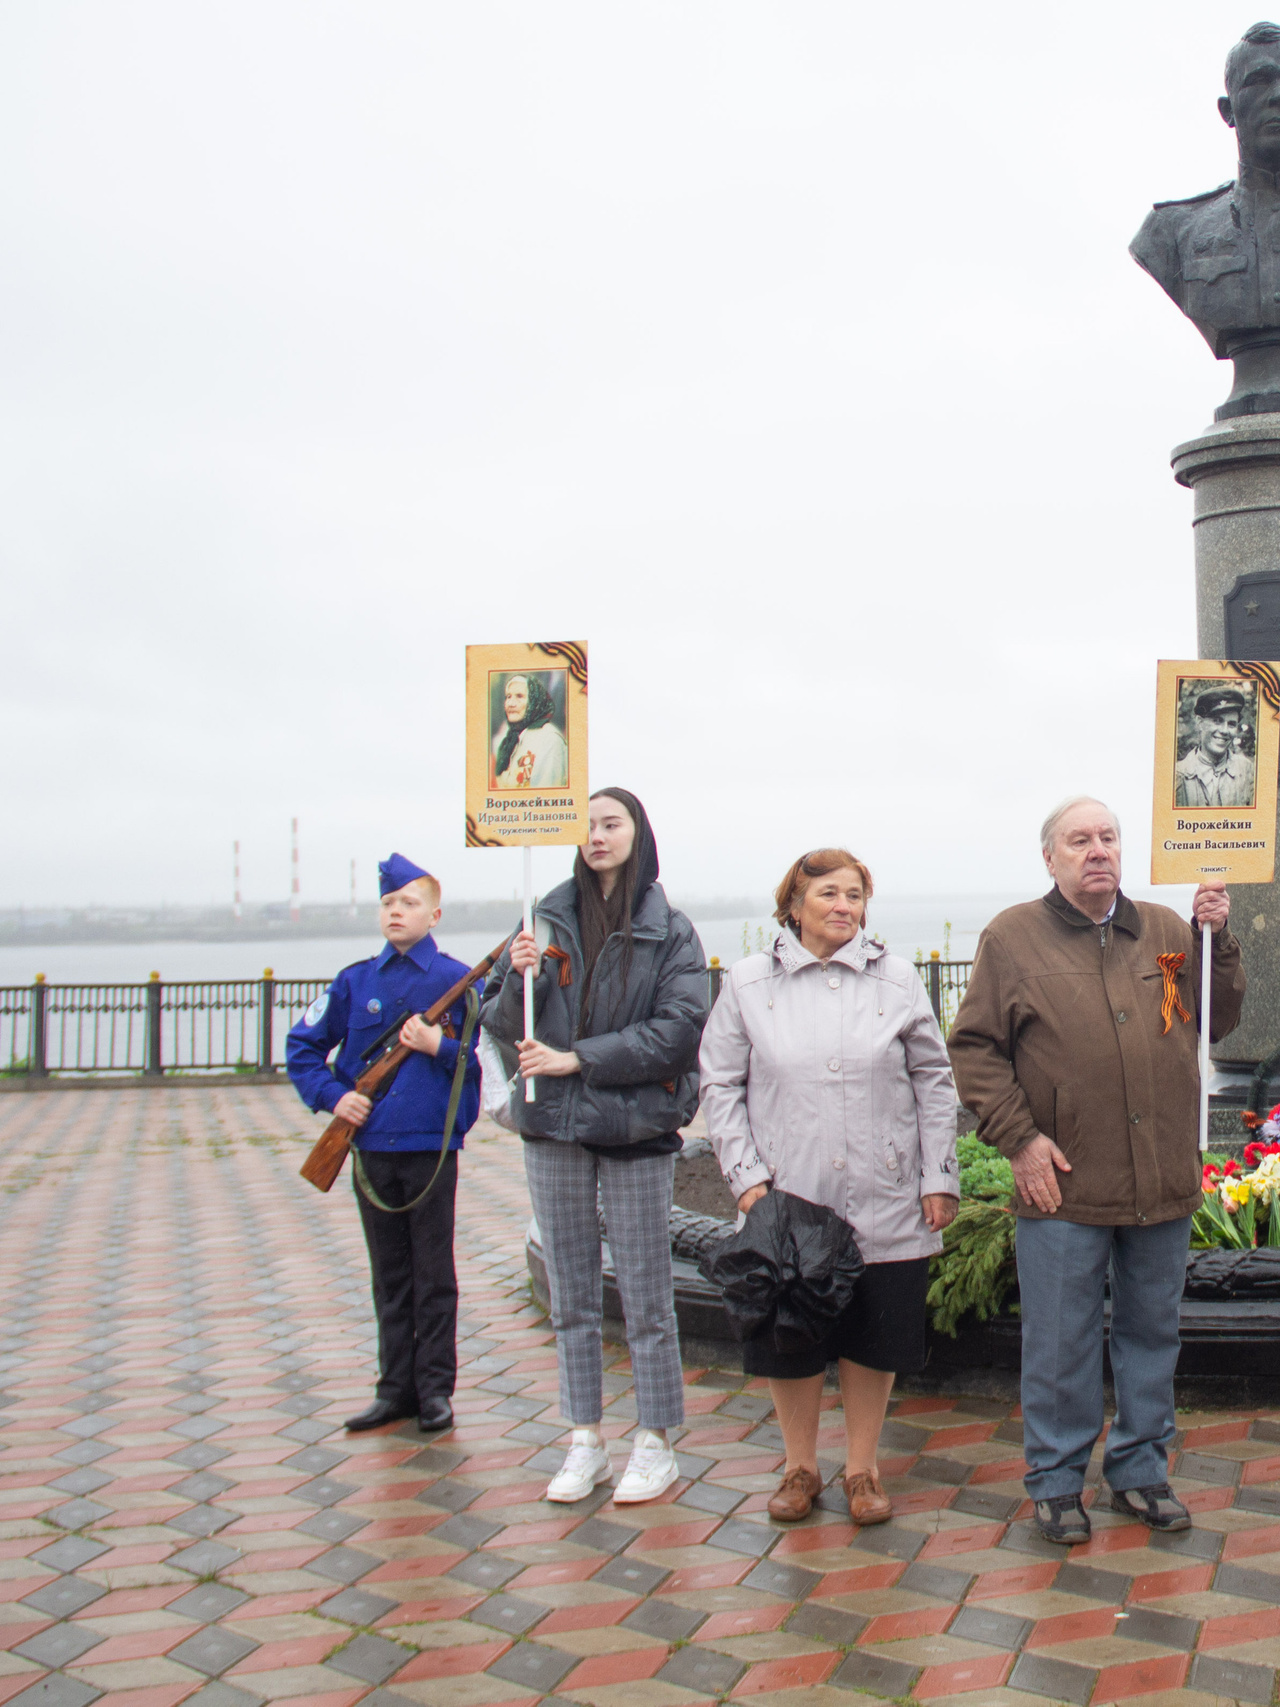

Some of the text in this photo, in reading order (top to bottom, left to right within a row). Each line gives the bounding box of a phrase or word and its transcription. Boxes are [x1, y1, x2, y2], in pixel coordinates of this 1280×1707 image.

[486, 797, 574, 811] Ворожейкина
[478, 811, 578, 824] Ираида Ивановна
[1176, 819, 1252, 832] Ворожейкин
[1164, 840, 1266, 850] Степан Васильевич
